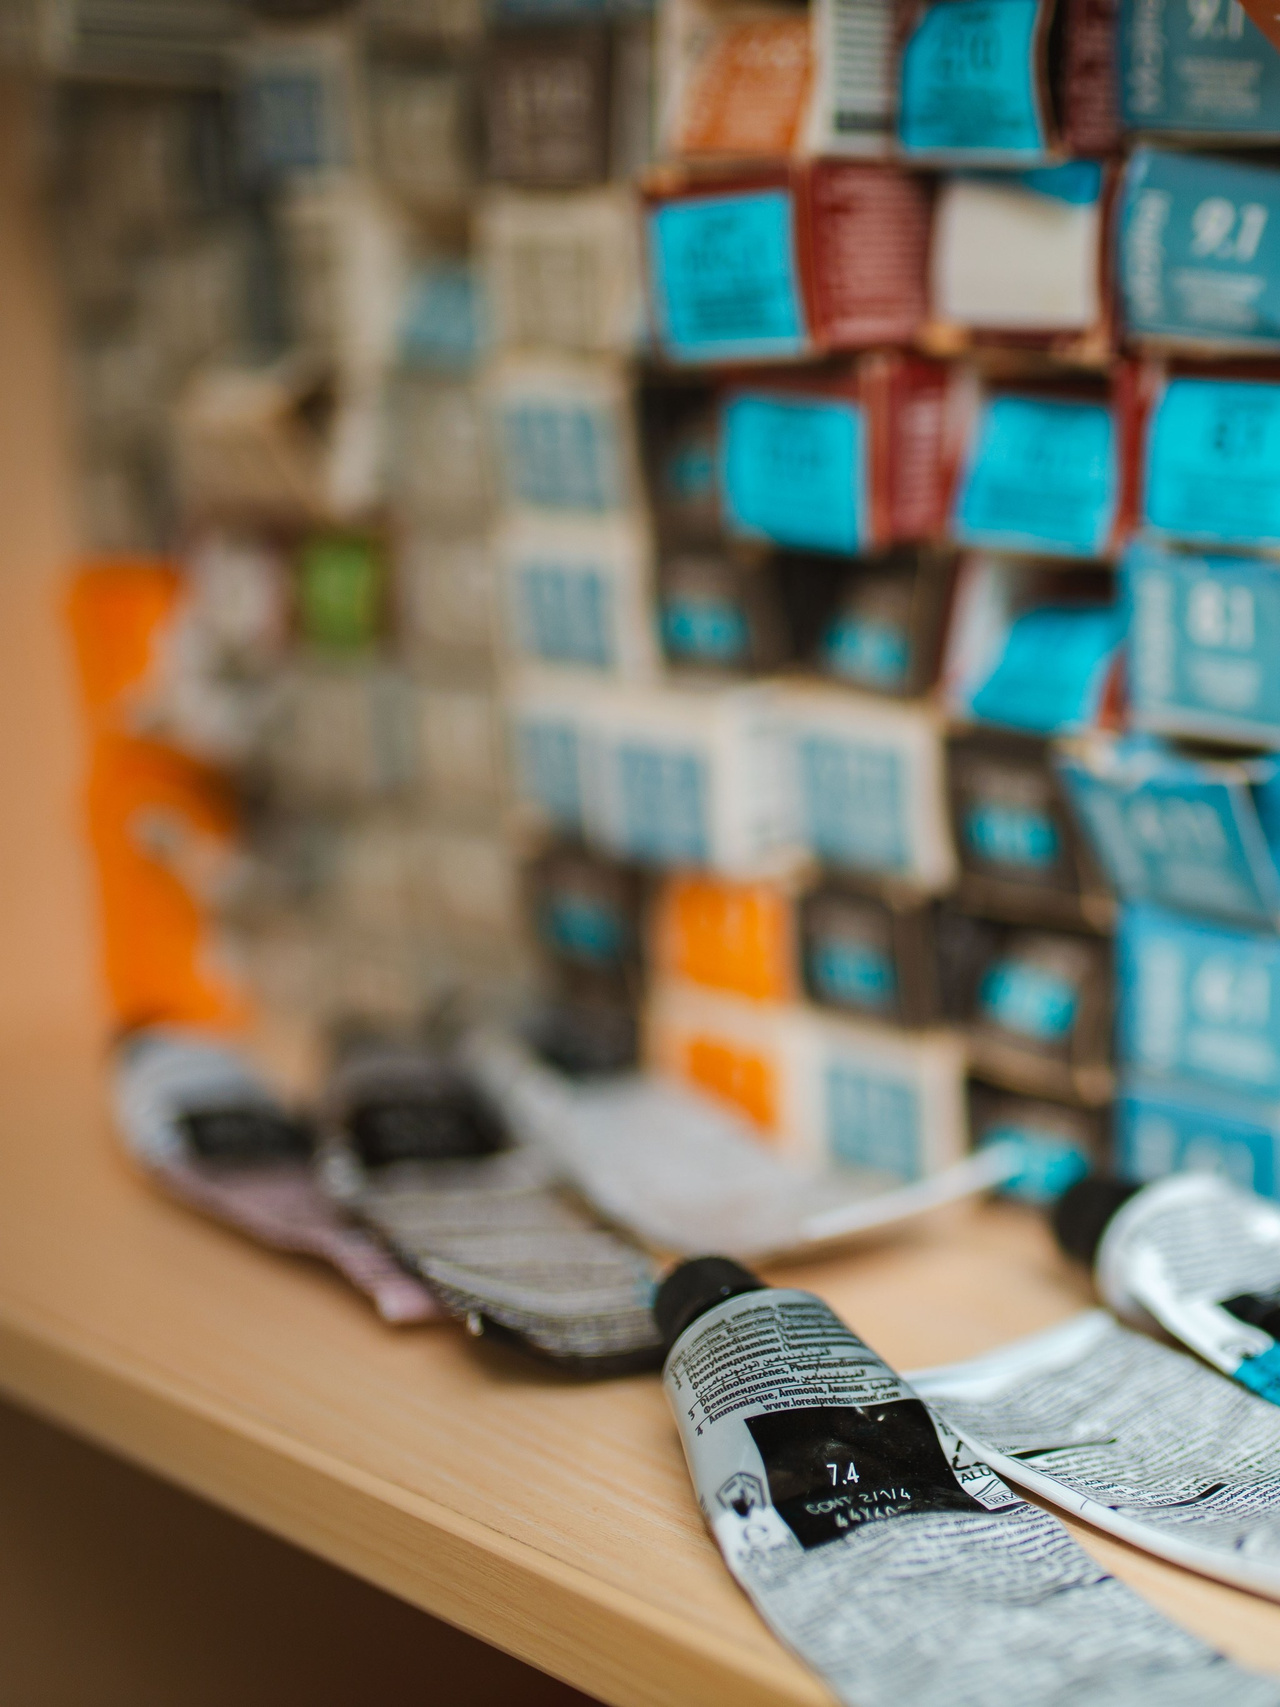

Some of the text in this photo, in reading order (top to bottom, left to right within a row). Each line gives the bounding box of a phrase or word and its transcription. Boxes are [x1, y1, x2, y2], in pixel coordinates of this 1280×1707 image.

[691, 1346, 783, 1390] Фенилендиамины
[699, 1366, 789, 1408] Diaminobenzènes,
[703, 1376, 800, 1415] Фенилендиамины,
[709, 1392, 778, 1424] Ammoniaque,
[779, 1385, 827, 1398] Ammonia,
[826, 1462, 860, 1486] 7.4
[961, 1466, 992, 1484] ALU
